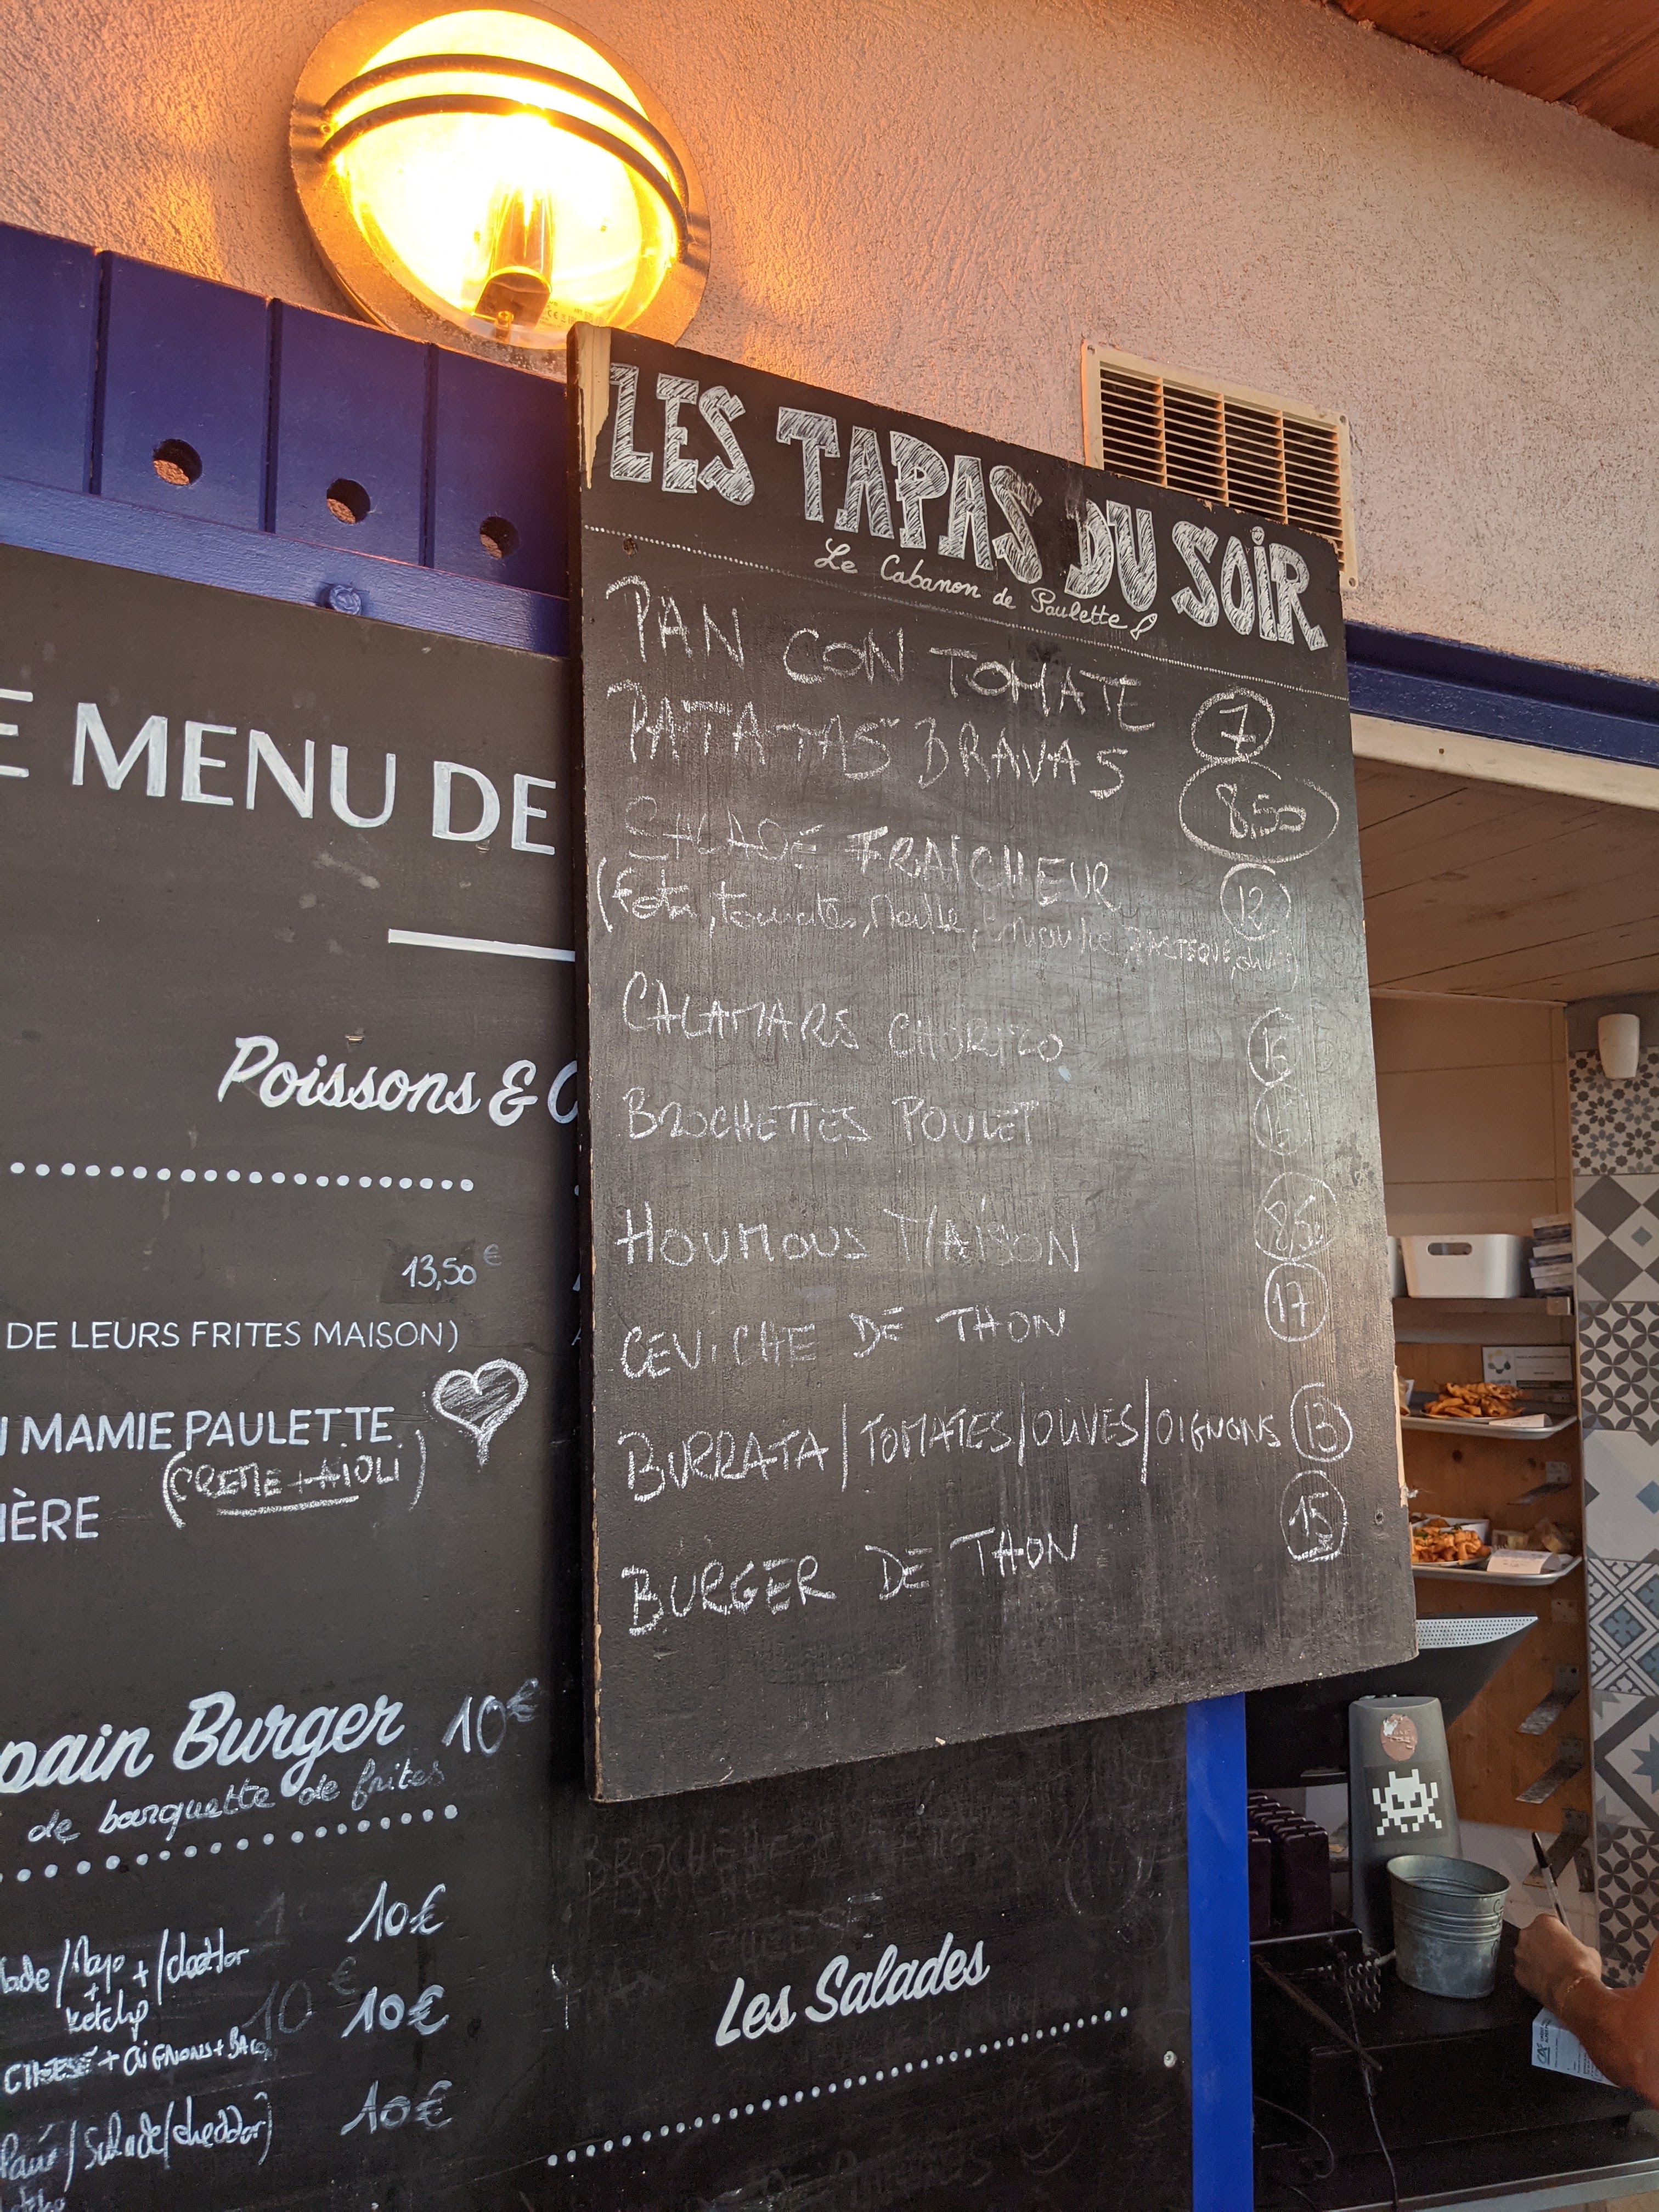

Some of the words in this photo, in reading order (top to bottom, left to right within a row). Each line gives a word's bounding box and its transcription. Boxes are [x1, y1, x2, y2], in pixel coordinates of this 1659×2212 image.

[610, 362, 755, 506] LES
[777, 407, 1042, 584] TAPAS
[1065, 496, 1158, 613] DU
[814, 537, 858, 574] Le
[881, 554, 981, 599] Cabanon
[993, 588, 1016, 610] de
[1030, 588, 1128, 629] Paulette
[606, 574, 744, 670] PAN
[783, 625, 905, 686] CON
[927, 647, 1155, 732] TOMATE
[72, 703, 396, 828] MENU
[432, 761, 556, 855] DE
[915, 717, 1129, 800] BRAVAS
[219, 1036, 480, 1115] Poissons
[488, 1060, 538, 1126] &
[891, 1096, 1039, 1144] POULET
[402, 1254, 477, 1290] 13,50
[7, 1321, 58, 1350] DE
[71, 1321, 180, 1349] LEURS
[191, 1321, 301, 1350] FRITES
[314, 1320, 458, 1353] MAISON)
[621, 1321, 816, 1379] CEVICHE
[850, 1307, 904, 1358] DE
[936, 1305, 1066, 1343] THON
[21, 1410, 175, 1455] MAMIE
[185, 1406, 395, 1452] PAULETTE
[622, 1555, 837, 1637] BURGER
[865, 1545, 933, 1600] DE
[950, 1524, 1079, 1578] THON
[173, 1691, 405, 1797] Burger
[27, 1809, 81, 1844] de
[99, 1778, 275, 1842] barquette
[299, 1774, 340, 1805] de
[351, 1758, 445, 1810] frites
[347, 1881, 446, 1943] 10€
[341, 1983, 449, 2039] 10€
[715, 1977, 796, 2046] Les
[805, 1932, 990, 2022] Salades
[340, 2080, 453, 2136] 10€
